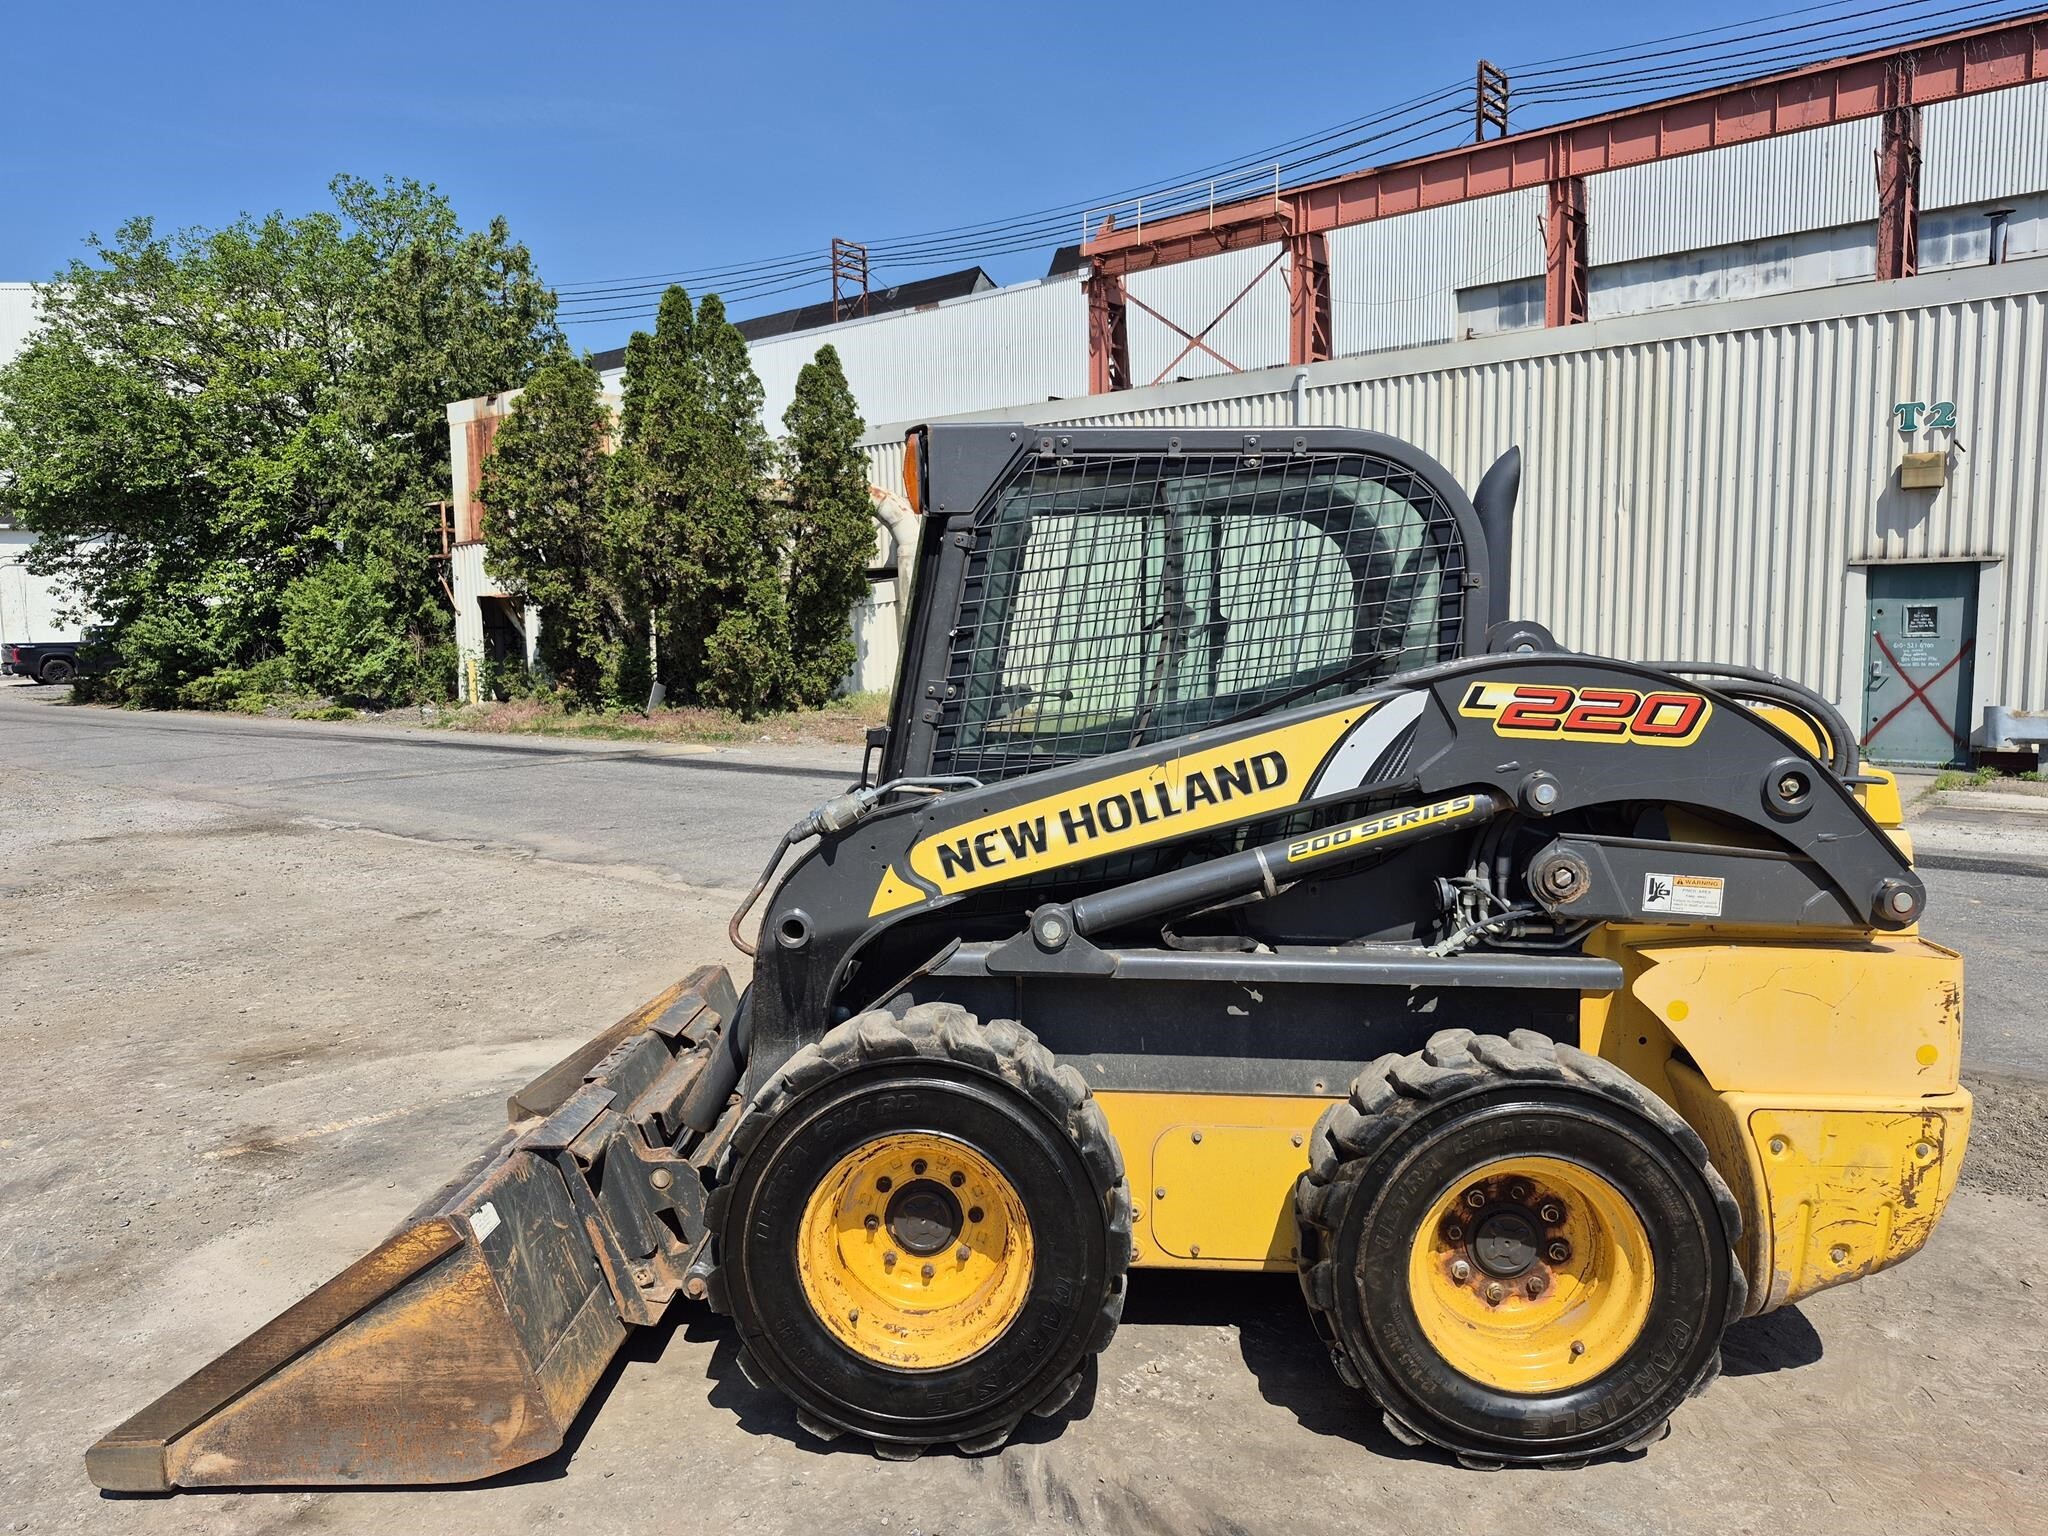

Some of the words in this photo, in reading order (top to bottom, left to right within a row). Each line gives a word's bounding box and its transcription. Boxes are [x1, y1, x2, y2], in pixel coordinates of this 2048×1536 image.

[936, 815, 1048, 880] NEW
[1059, 750, 1289, 844] HOLLAND
[1291, 829, 1352, 858] 200
[1361, 796, 1471, 838] SERIES
[1685, 878, 1719, 887] WARNING
[815, 1094, 920, 1144] GUARD
[1453, 1118, 1562, 1155] GUARD
[1522, 1318, 1692, 1438] CARLISLE
